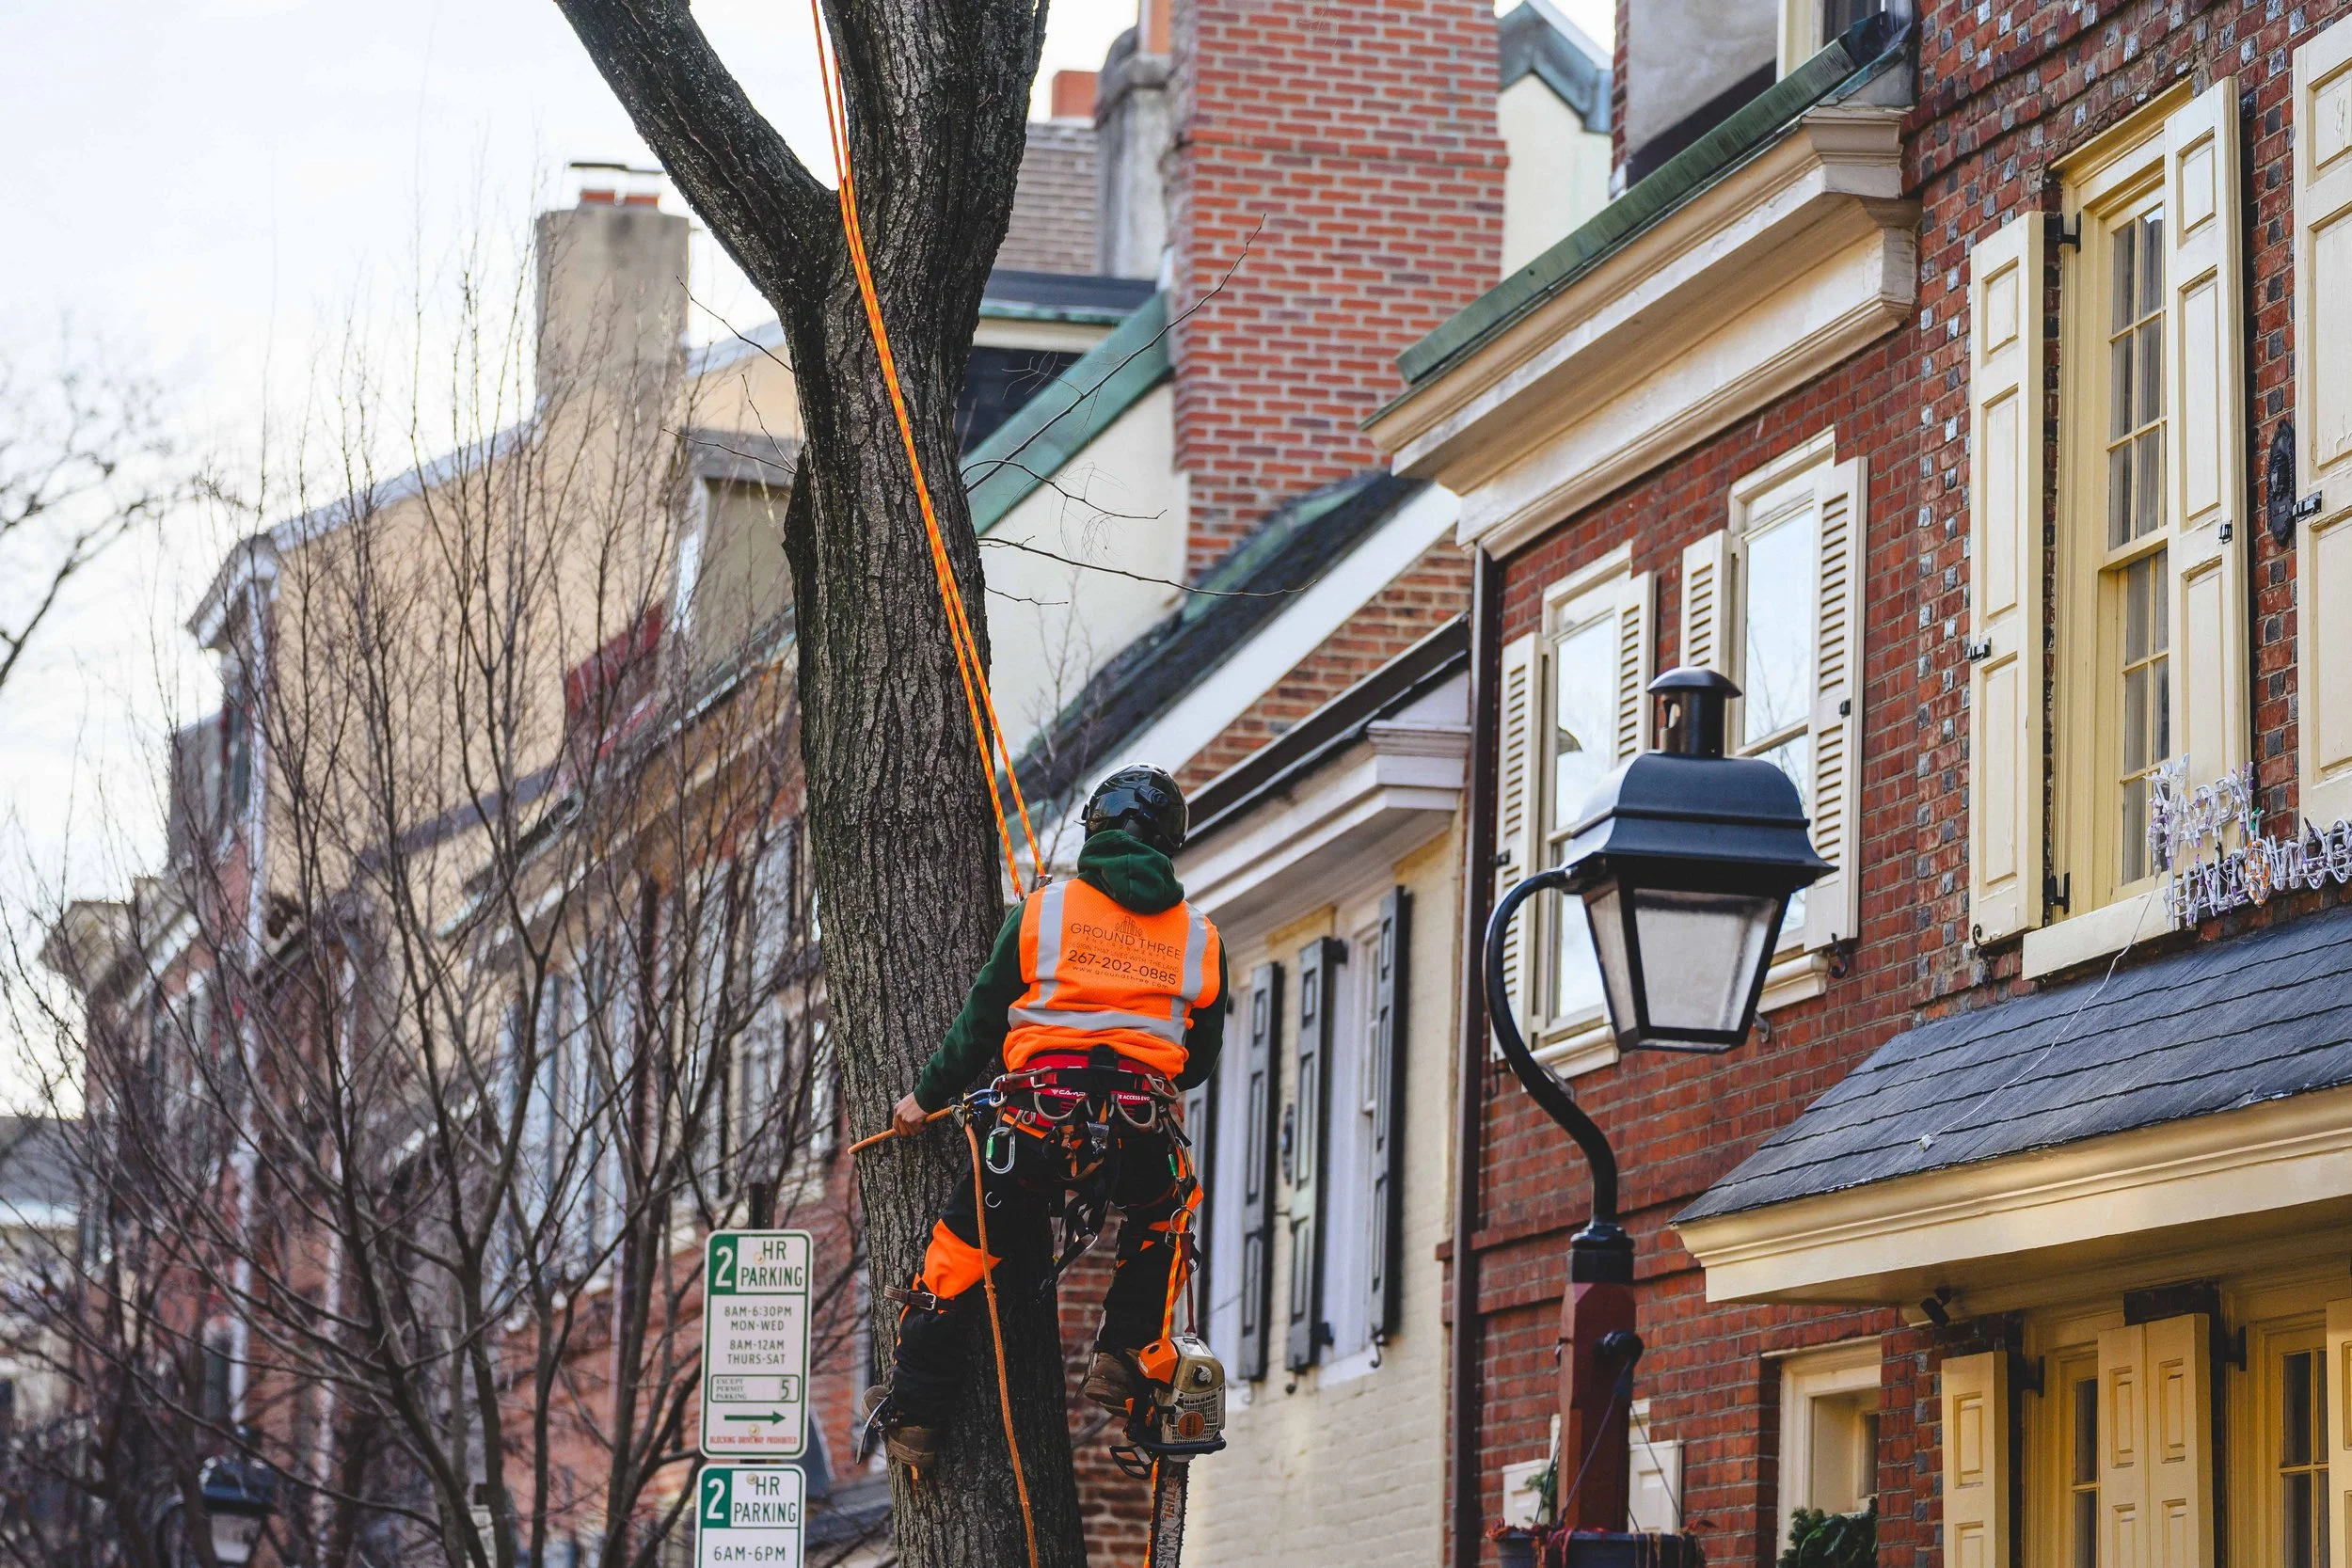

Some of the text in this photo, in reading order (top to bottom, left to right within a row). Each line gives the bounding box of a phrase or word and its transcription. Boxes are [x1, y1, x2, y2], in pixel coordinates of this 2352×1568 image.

[1071, 923, 1182, 959] GROUND THREE
[1093, 946, 1109, 955] THAT
[1110, 951, 1128, 959] LIVES
[1068, 949, 1177, 985] 267-202-0885
[1073, 966, 1168, 990] www.groundthree.com
[762, 1241, 787, 1260] HR
[715, 1245, 733, 1287] 2
[740, 1266, 803, 1287] PARKING
[724, 1307, 792, 1317] 8AM-6:30PM
[731, 1320, 785, 1331] MON-WED
[729, 1339, 785, 1351] 8AM-12AM
[726, 1354, 787, 1365] THURS-SAT
[781, 1379, 790, 1400] 5
[710, 1436, 736, 1445] BLOCKING
[755, 1476, 780, 1496] HR
[707, 1478, 725, 1519] 2
[1161, 1478, 1179, 1522] STIHL
[734, 1502, 796, 1522] PARKING
[713, 1545, 786, 1561] 6AM-6PM
